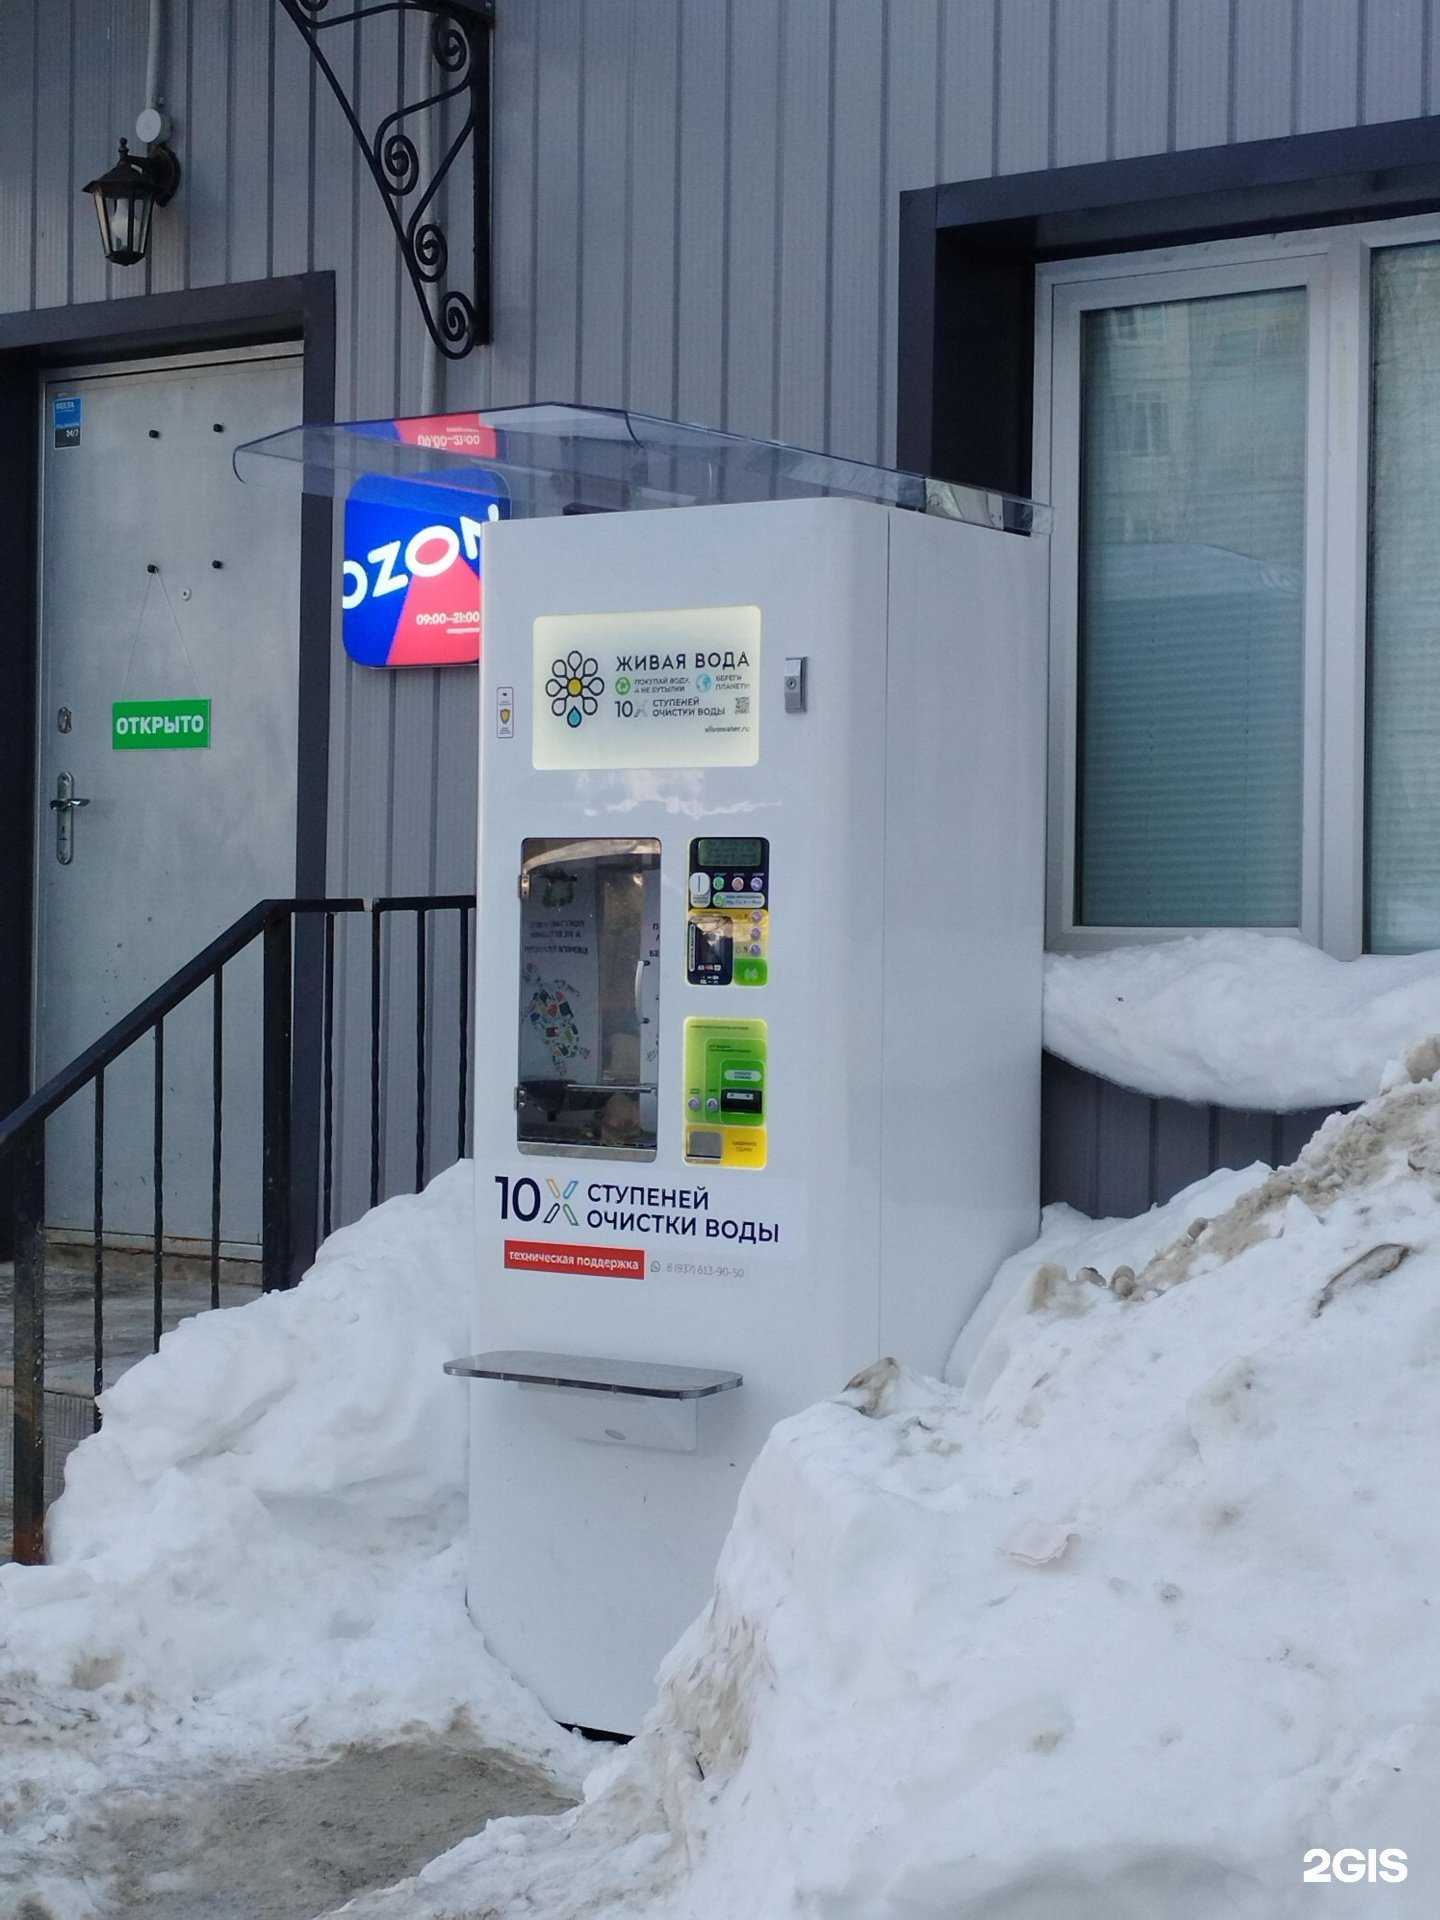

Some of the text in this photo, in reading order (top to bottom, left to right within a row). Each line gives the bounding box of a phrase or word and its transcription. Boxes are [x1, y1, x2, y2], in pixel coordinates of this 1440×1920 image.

[616, 651, 750, 671] ЖИВАЯ ВОДА
[652, 696, 700, 707] СТУПЕНЕЙ
[652, 707, 726, 718] ОЧИСТКИ ВОДЫ
[116, 714, 204, 735] ОТКРЫТО
[587, 1183, 709, 1210] СТУПЕНЕЙ
[587, 1210, 779, 1244] ОЧИСТКИ ВОДЫ
[510, 1251, 640, 1271] техническая поддержка
